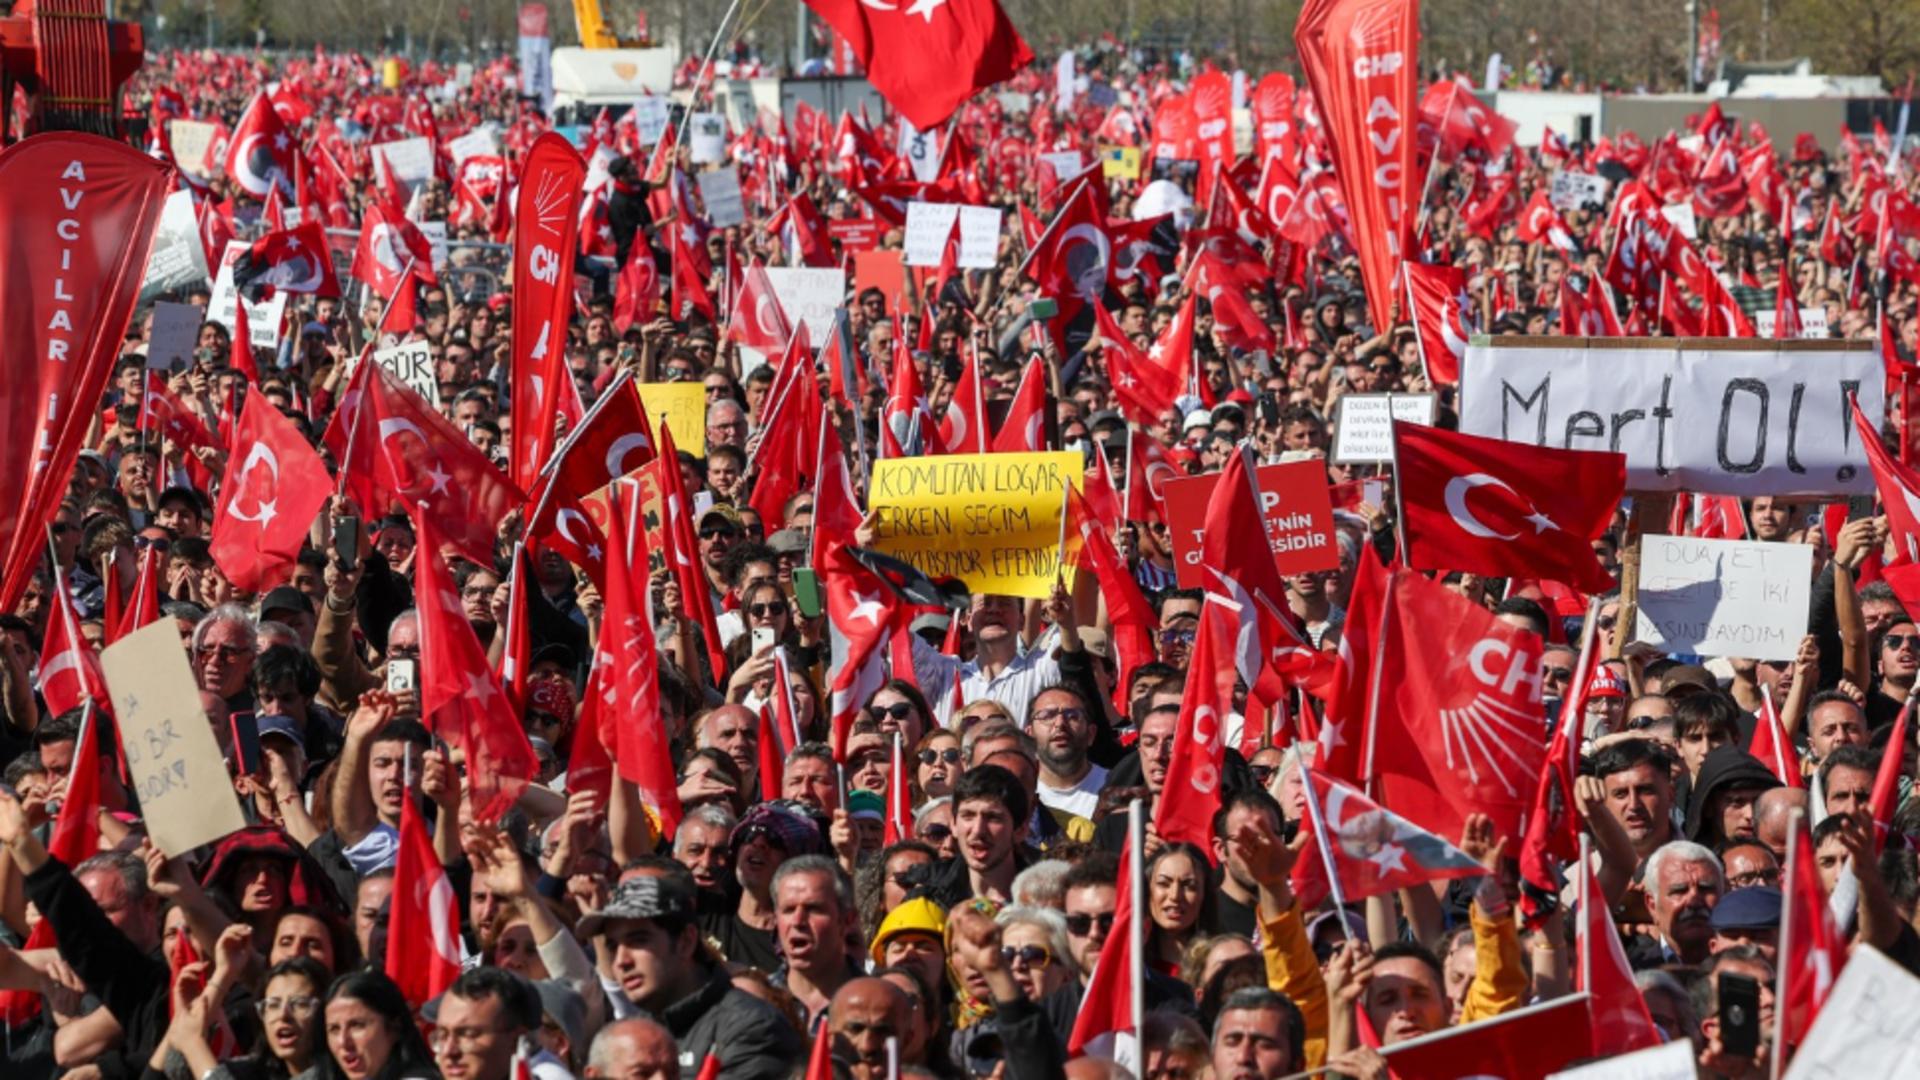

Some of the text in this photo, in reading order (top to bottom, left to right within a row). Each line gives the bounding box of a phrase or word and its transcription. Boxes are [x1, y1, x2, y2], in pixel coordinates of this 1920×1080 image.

[1353, 50, 1403, 79] CHP
[47, 159, 86, 361] AVCILAR
[1502, 371, 1674, 476] Mert
[879, 462, 1065, 498] KOMUTAN LOGAR
[876, 505, 951, 539] ERKEN
[1662, 541, 1772, 571] DUA ET
